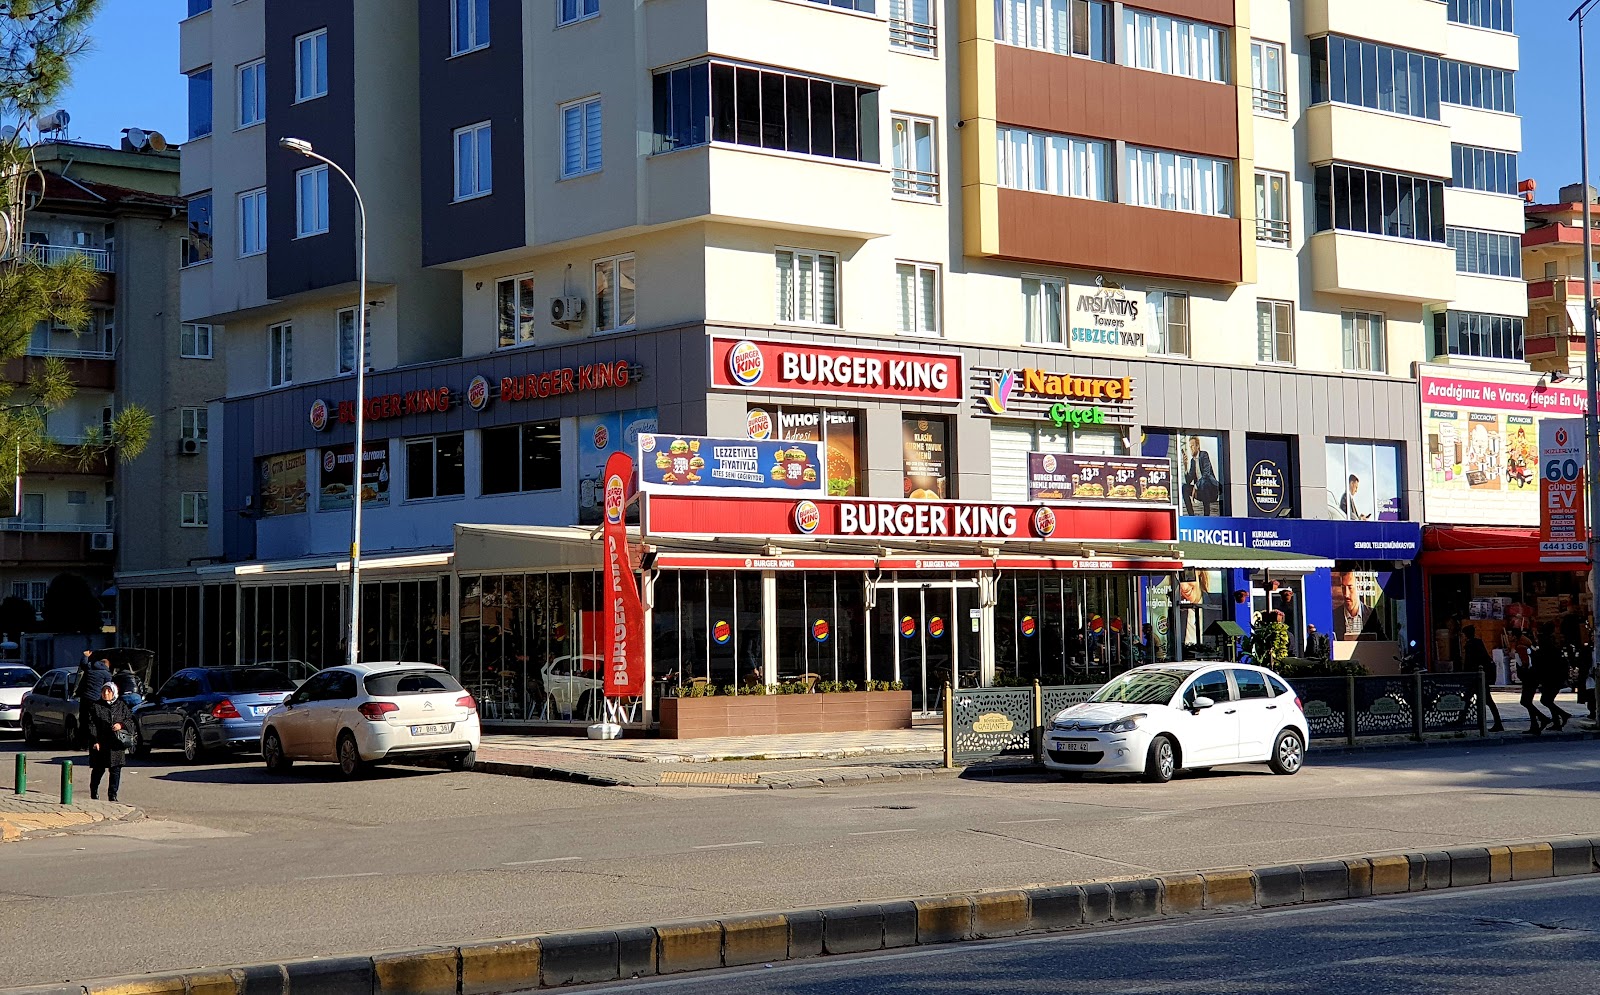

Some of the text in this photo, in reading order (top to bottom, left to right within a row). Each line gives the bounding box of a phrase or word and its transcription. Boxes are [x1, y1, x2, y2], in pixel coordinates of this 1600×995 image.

[1077, 294, 1138, 321] ARSLANTAŞ
[1093, 314, 1125, 328] Towers
[1071, 326, 1144, 347] SEBZECİ YAPI
[735, 349, 760, 364] BURGER
[736, 357, 761, 373] KING
[783, 352, 948, 390] BURGER KING
[501, 360, 629, 402] BURGER KING
[1024, 368, 1131, 400] Naturel
[405, 386, 449, 414] KING
[1428, 382, 1588, 410] Aradığınız Ne Varsa, Hepsi En Uyg
[748, 416, 768, 428] BURGER
[1050, 403, 1105, 428] Çiçek
[749, 421, 769, 435] KING
[785, 428, 811, 440] Adresi
[716, 448, 756, 458] LEZZETİYLE
[721, 460, 756, 471] FİYATIYLA
[1546, 459, 1578, 481] 60
[1256, 477, 1277, 486] destek
[1548, 483, 1577, 491] GÜNDE
[1548, 491, 1576, 508] EV
[801, 513, 818, 525] KING
[841, 503, 1016, 536] BURGER KING
[1039, 517, 1055, 530] KING
[1180, 528, 1243, 547] TURKCELL
[1252, 531, 1279, 539] KURUMSAL
[1252, 538, 1291, 548] ÇÖZÜM MERKEZİ
[753, 560, 794, 568] BURGER KING
[922, 560, 944, 568] BURGER
